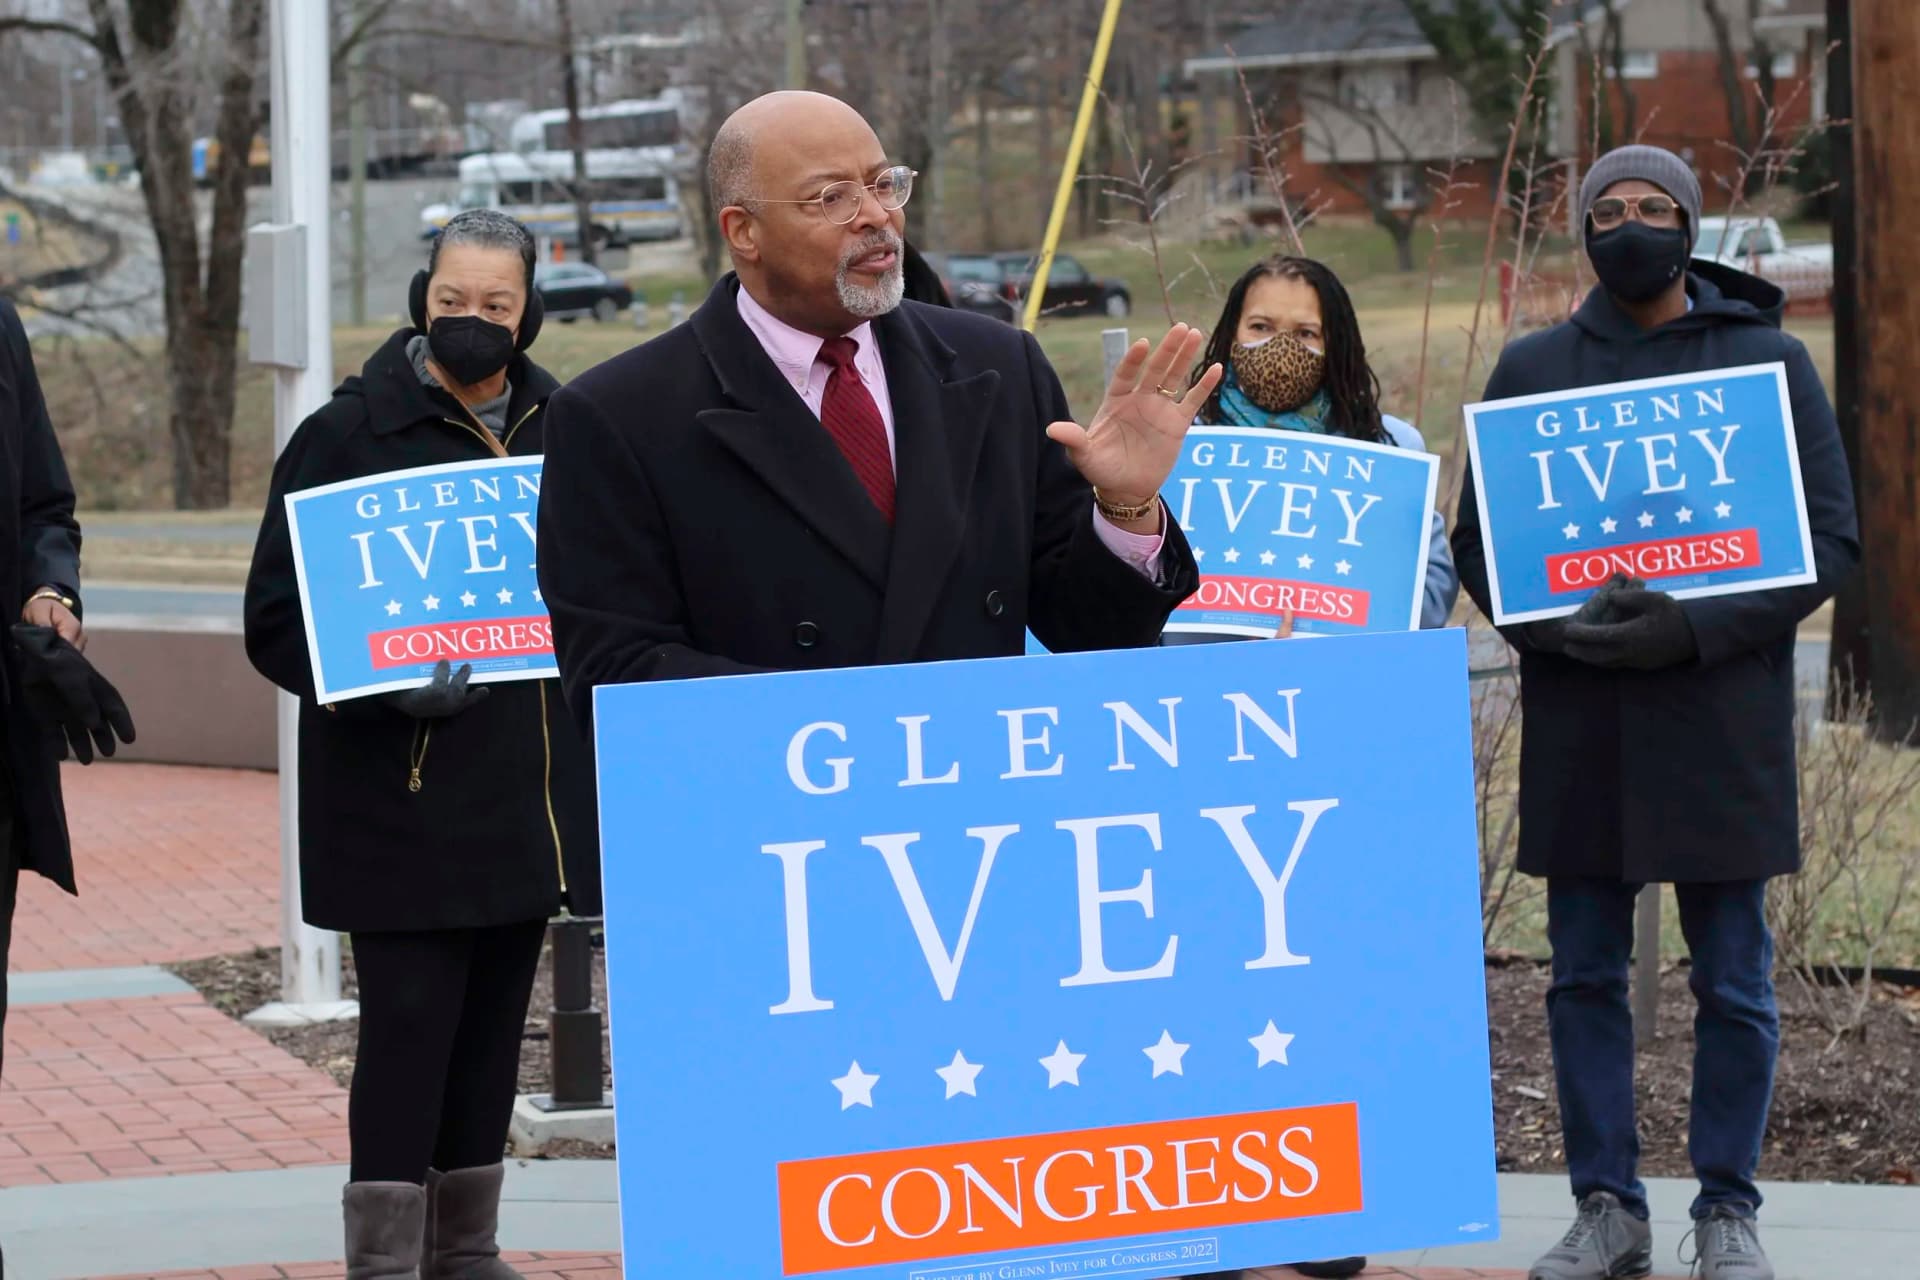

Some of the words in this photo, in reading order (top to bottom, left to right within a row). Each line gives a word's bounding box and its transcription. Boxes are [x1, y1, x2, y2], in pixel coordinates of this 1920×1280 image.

[1537, 388, 1724, 437] GLENN
[1192, 443, 1375, 482] GLENN
[1530, 425, 1741, 510] IVEY
[356, 473, 542, 519] GLENN
[1179, 478, 1382, 546] IVEY
[1560, 535, 1745, 585] CONGRESS
[1182, 581, 1353, 618] ONGRESS
[785, 688, 1302, 796] GLENN
[761, 798, 1340, 1015] IVEY
[817, 1126, 1319, 1248] CONGRESS
[1181, 1244, 1214, 1259] 2022
